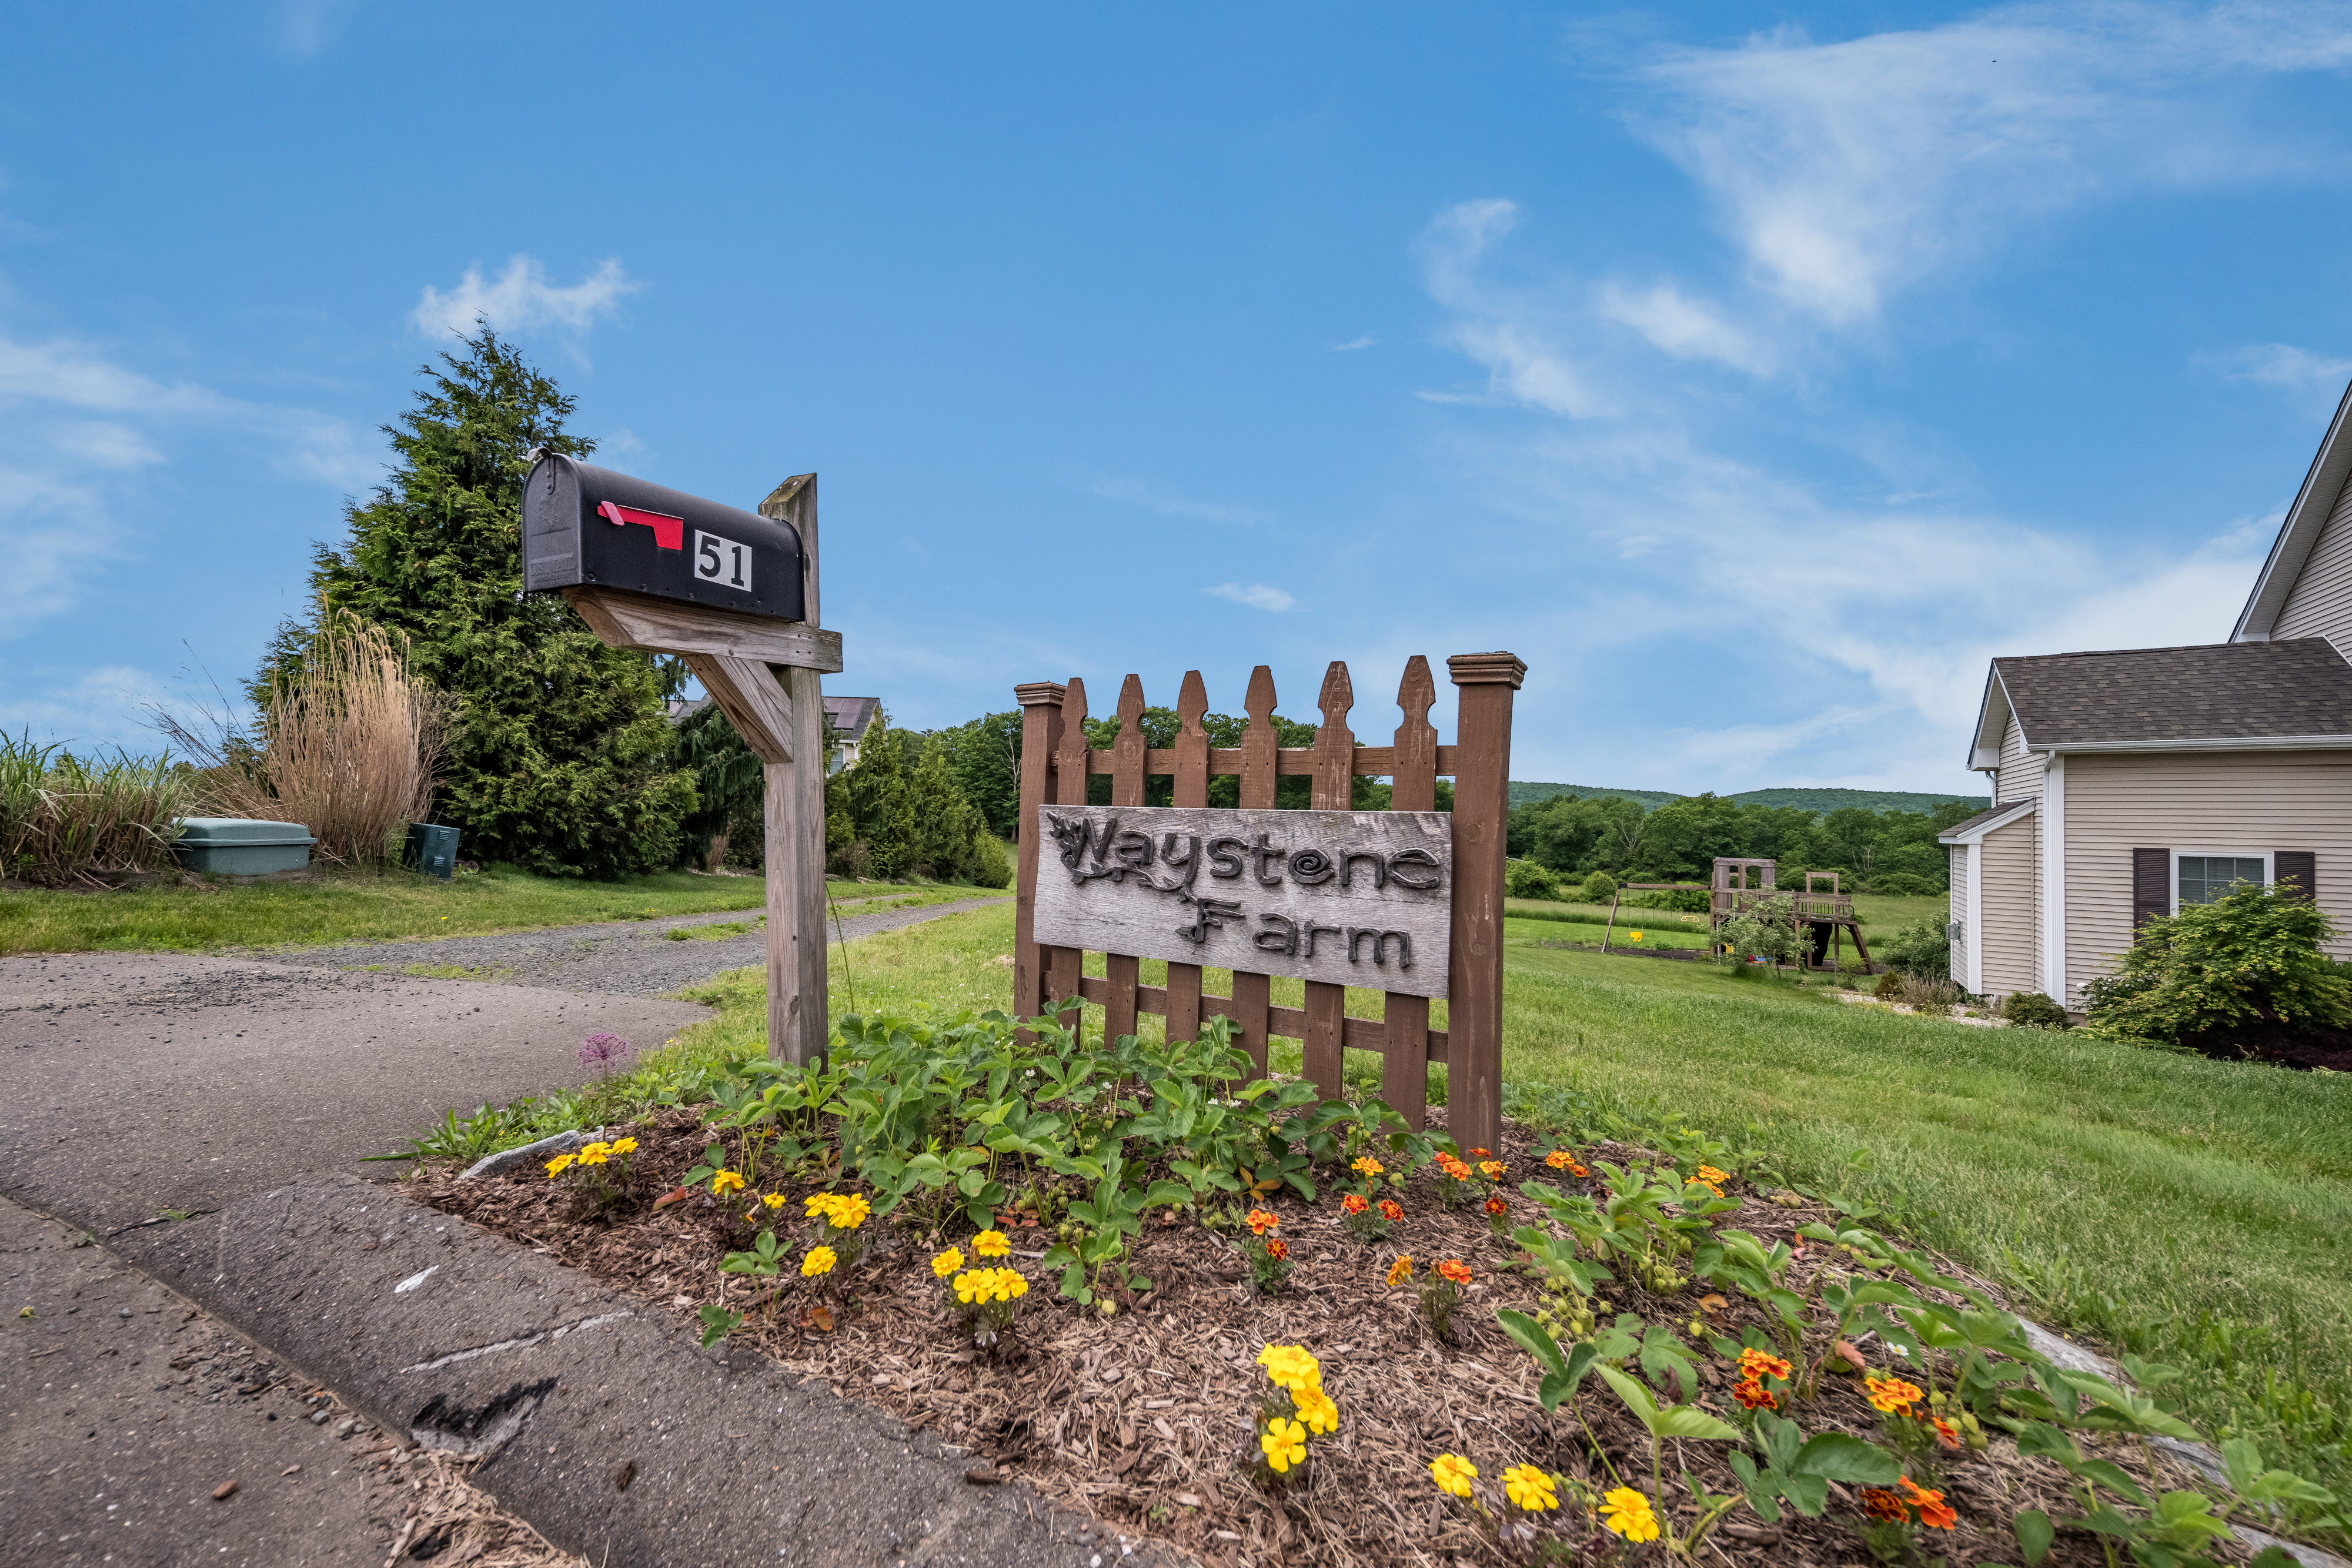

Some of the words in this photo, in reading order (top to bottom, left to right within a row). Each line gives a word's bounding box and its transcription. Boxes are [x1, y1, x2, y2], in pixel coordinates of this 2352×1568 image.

[699, 534, 744, 587] 51
[1057, 816, 1441, 890] Waystone
[1178, 897, 1411, 969] Farm
